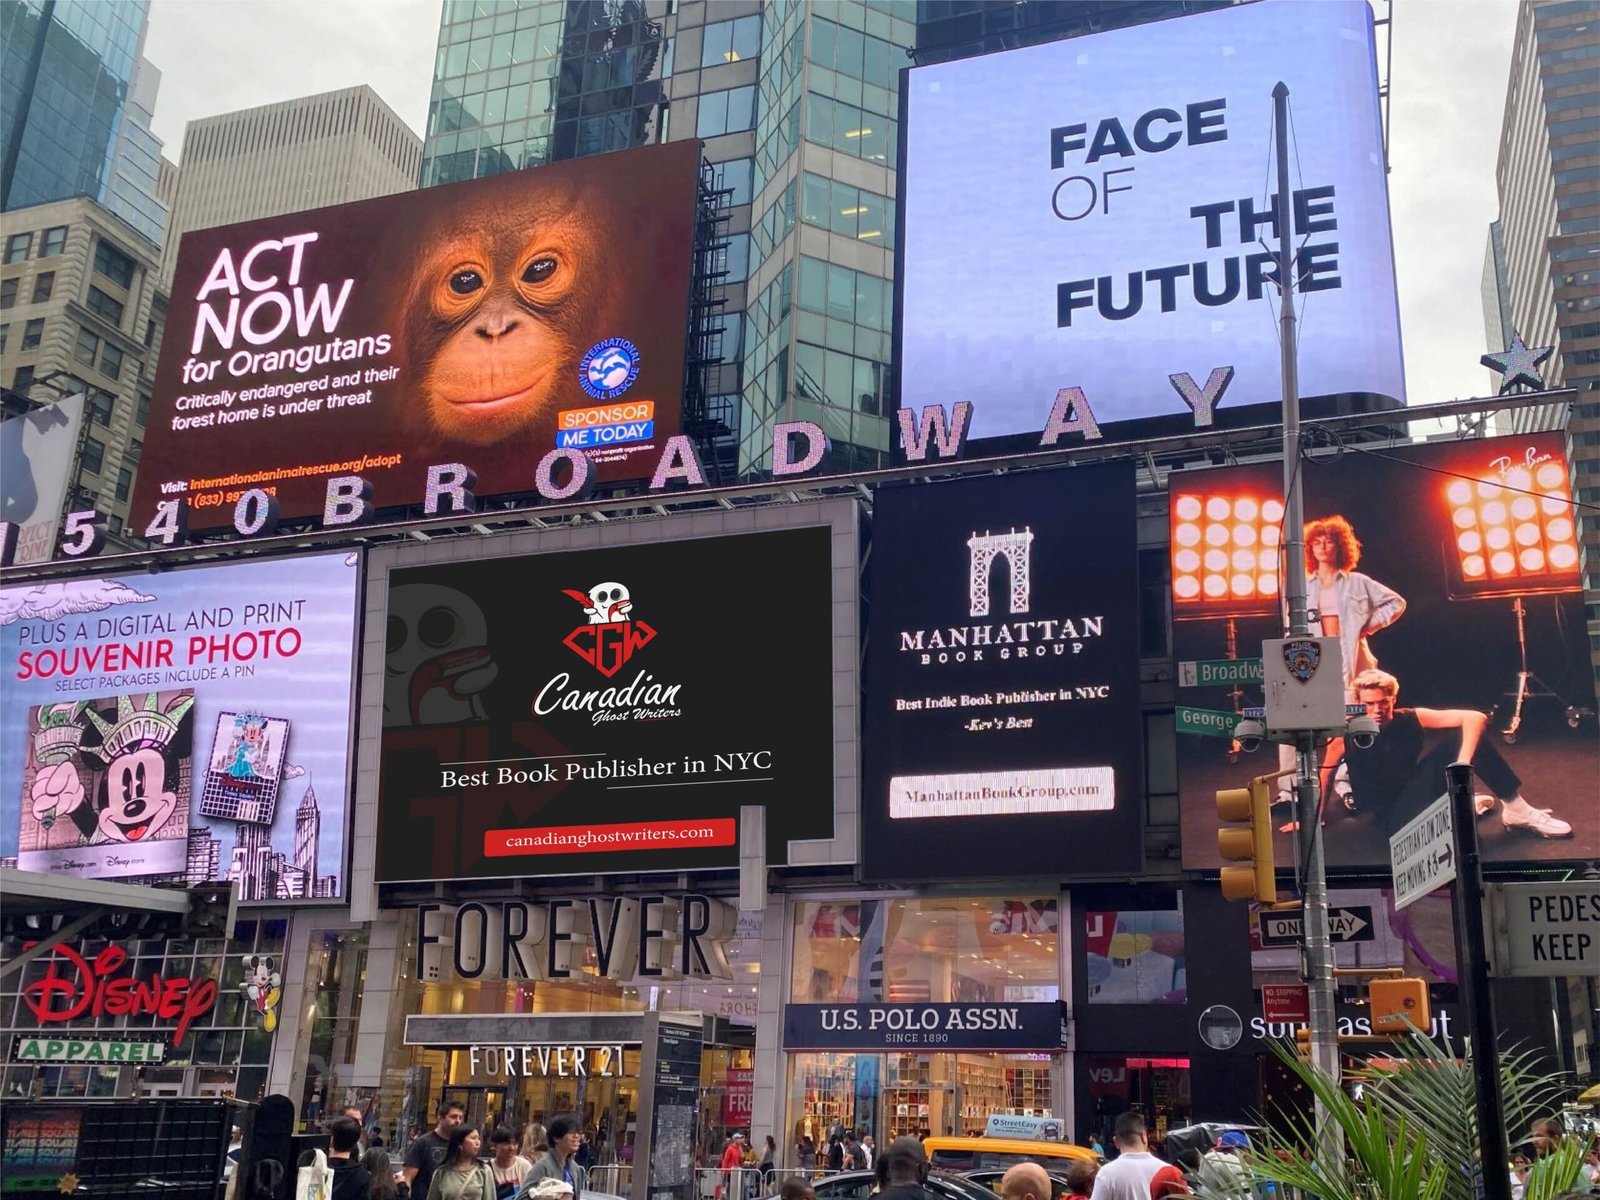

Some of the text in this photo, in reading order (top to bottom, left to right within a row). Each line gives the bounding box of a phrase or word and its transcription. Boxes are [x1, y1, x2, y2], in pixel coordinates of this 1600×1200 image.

[1050, 97, 1229, 170] FACE
[1051, 166, 1135, 221] OF
[1190, 185, 1338, 249] THE
[197, 232, 318, 300] ACT
[1056, 242, 1342, 329] FUTURE
[191, 279, 354, 354] NOW
[182, 333, 392, 384] for Orangutans
[579, 338, 641, 371] INTERNATIONAL
[175, 366, 400, 411] Critically endangered and their
[579, 367, 640, 400] ANIMAL RESCUE
[171, 389, 372, 431] forest home is under threat
[564, 404, 649, 428] SPONSOR
[563, 423, 648, 447] ME TODAY
[160, 453, 402, 495] Visit: internationalanimalrescue.org/adopt
[194, 491, 224, 509] (833)
[18, 600, 306, 646] PLUS A DIGITAL AND PRINT
[899, 616, 1103, 651] MANHATTAN
[16, 627, 302, 681] SOUVENIR PHOTO
[921, 642, 1084, 665] BOOK GROUP
[55, 665, 255, 692] SELECT PACKAGES INCLUDE A PIN
[533, 669, 682, 716] Canadian
[896, 685, 1110, 711] Best Indie Book Publisher in NYC
[591, 706, 682, 726] Ghost Writers
[1005, 717, 1033, 729] Best
[1182, 710, 1234, 730] George
[440, 750, 773, 789] Best Book Publisher in NYC
[906, 783, 1099, 804] ManhattanBookGroup.com
[505, 825, 715, 848] canadianghostwriters.com
[1393, 807, 1451, 866] PEDESTRIAN FLOW ZONE
[1396, 860, 1426, 896] KEEP MOVING
[416, 894, 715, 981] FOREVER
[1277, 921, 1303, 935] ON
[1532, 933, 1591, 961] KEEP
[821, 1008, 1023, 1030] U.S. POLO ASSN.
[20, 1041, 161, 1061] APPAREL
[886, 1033, 948, 1043] SINCE 1890
[470, 1045, 623, 1077] FOREVER 21
[1000, 1119, 1038, 1130] StreetEasy
